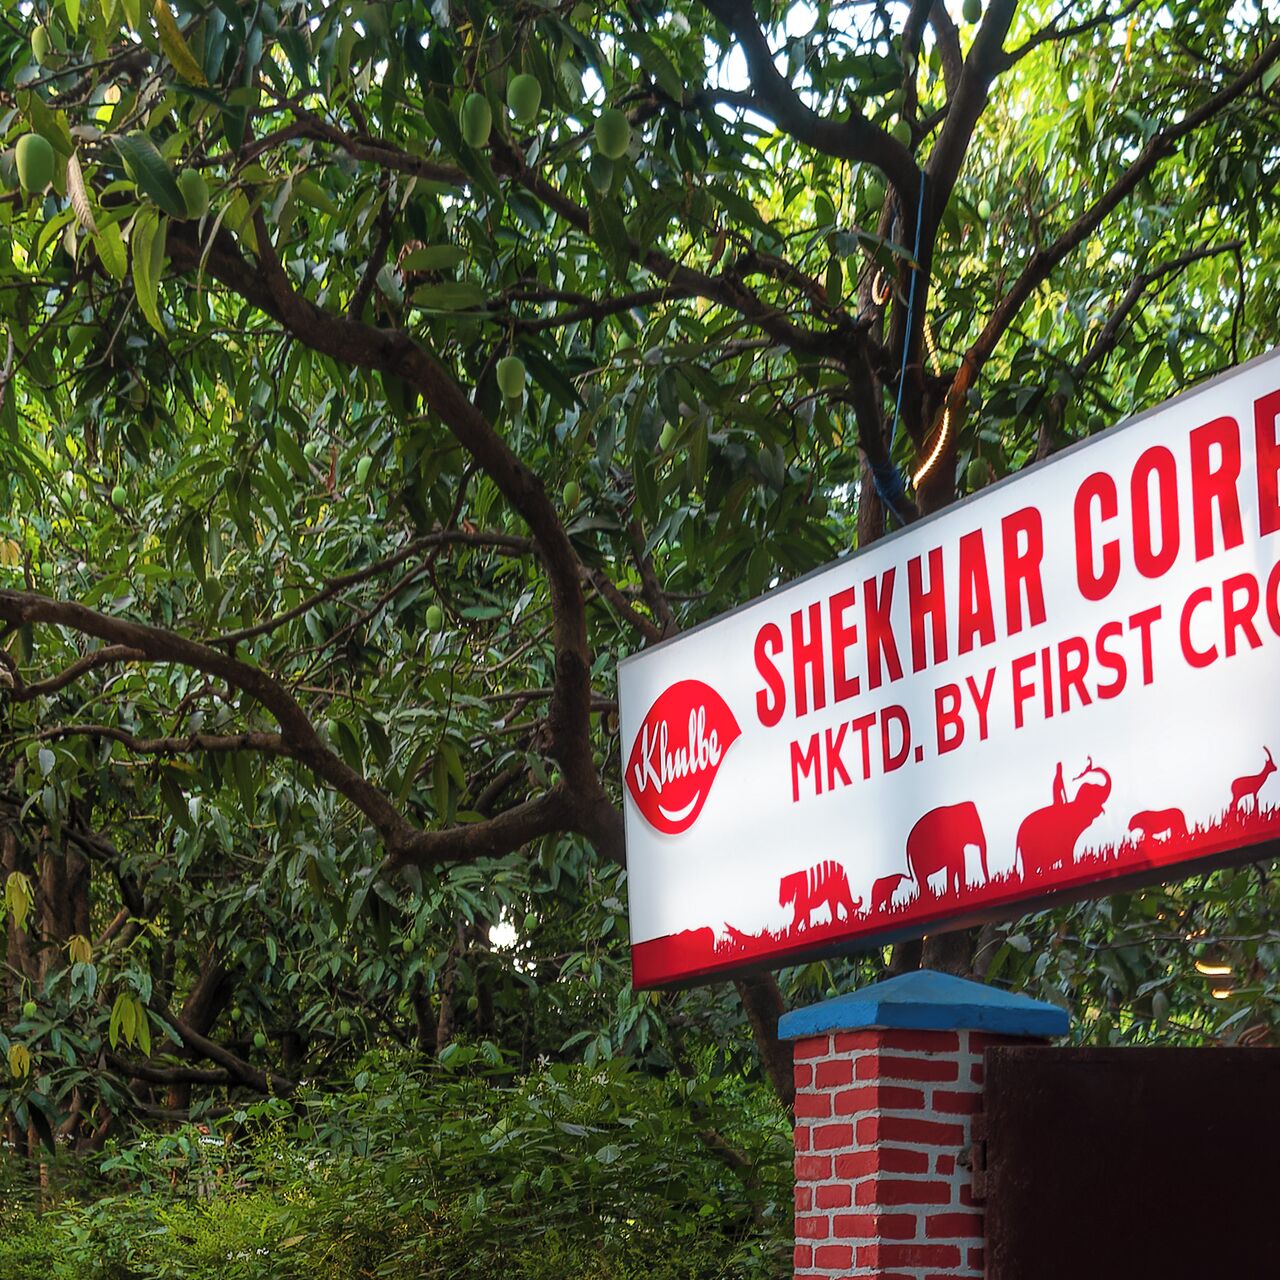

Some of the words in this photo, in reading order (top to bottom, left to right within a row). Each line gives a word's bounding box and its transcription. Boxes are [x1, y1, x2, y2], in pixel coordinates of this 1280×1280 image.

[753, 506, 1046, 728] SHEKHAR
[789, 704, 925, 803] MKTD.
[934, 666, 998, 756] BY
[1011, 604, 1162, 730] FIRST
[633, 704, 723, 795] Khulbe
